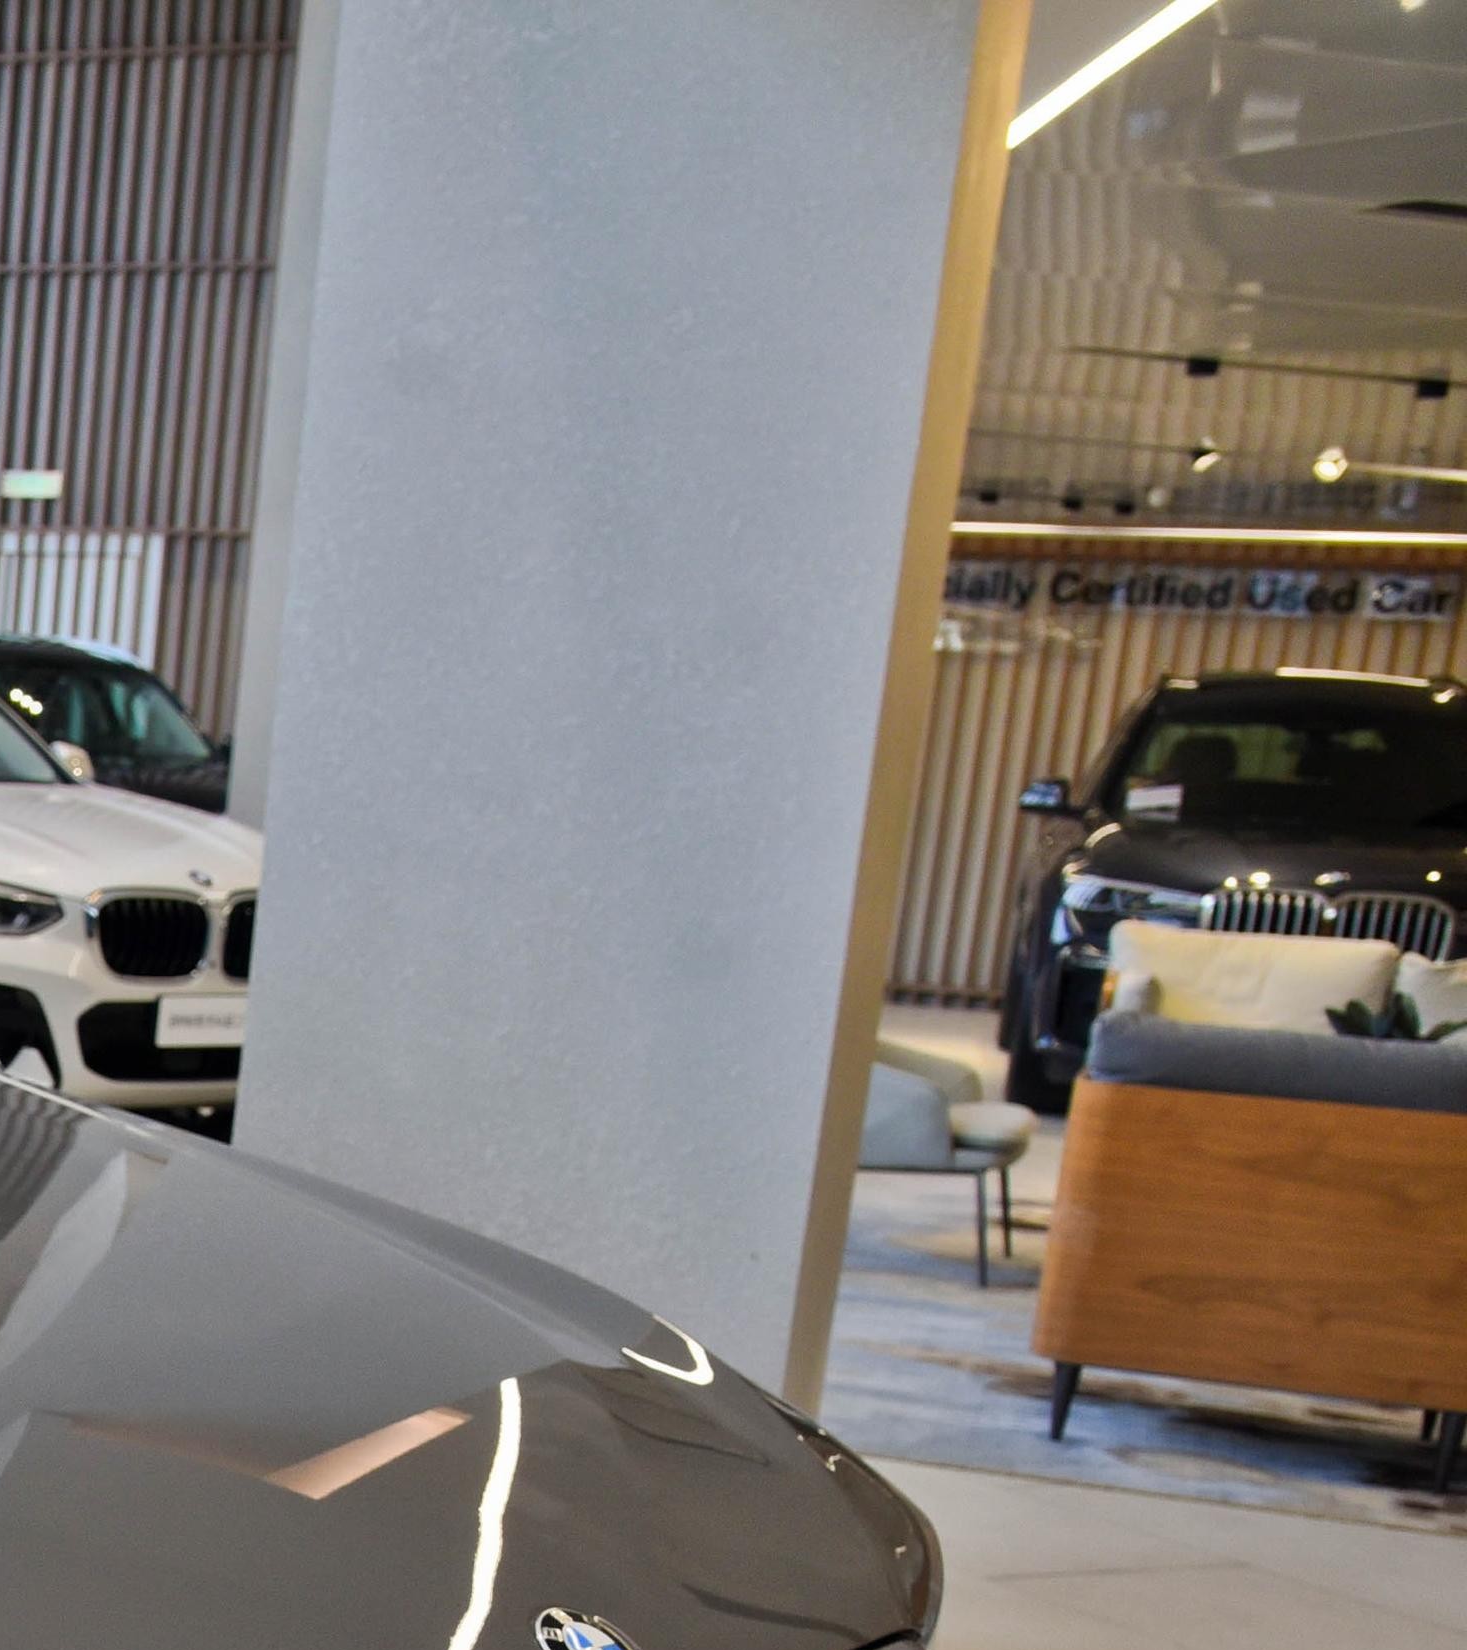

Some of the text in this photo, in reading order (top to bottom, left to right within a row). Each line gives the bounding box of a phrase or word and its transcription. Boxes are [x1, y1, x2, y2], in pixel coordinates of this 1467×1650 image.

[945, 566, 1452, 613] ially Certified Used Car
